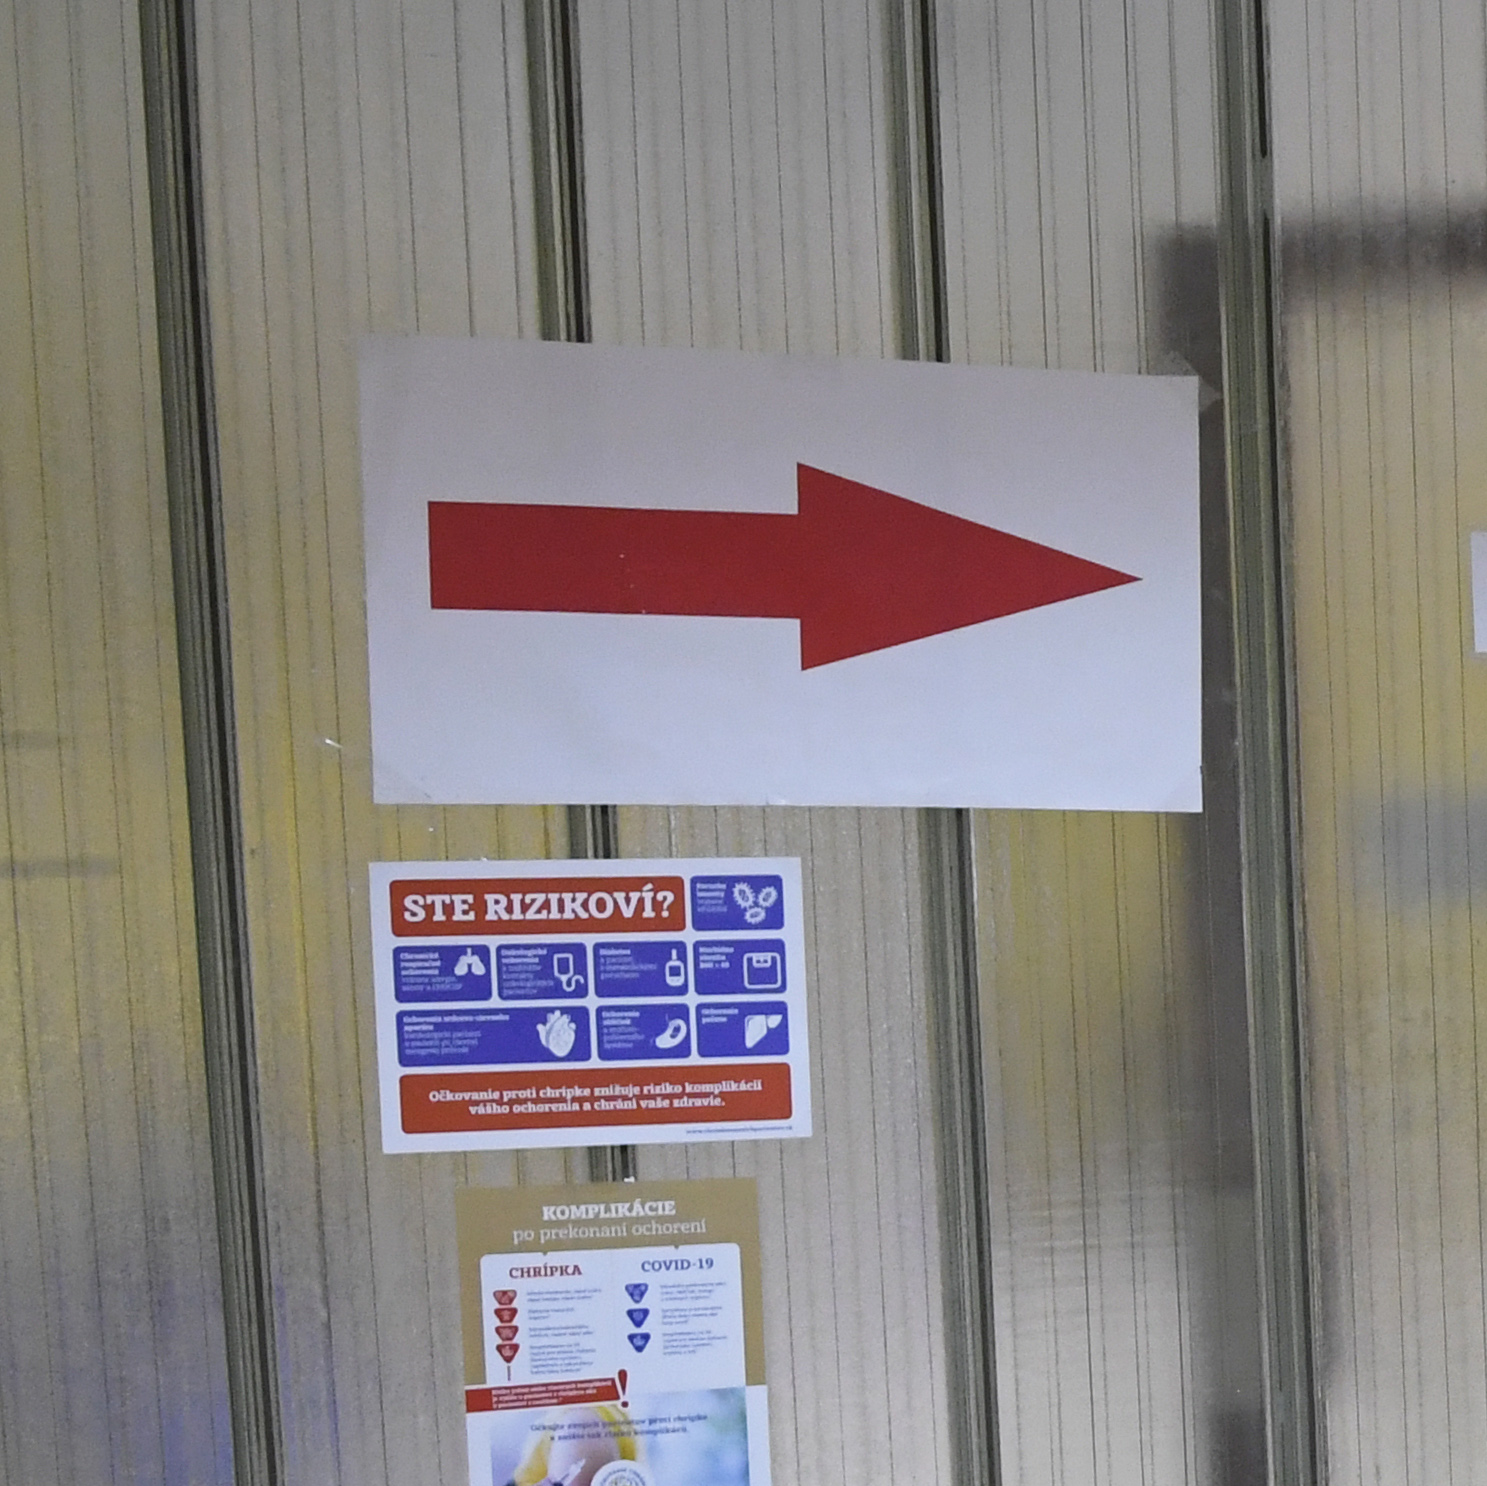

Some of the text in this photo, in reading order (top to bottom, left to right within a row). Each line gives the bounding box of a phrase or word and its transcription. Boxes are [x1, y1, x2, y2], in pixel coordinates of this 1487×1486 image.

[403, 894, 475, 922] STE
[484, 883, 675, 921] RIZIKOVÍ?
[429, 1088, 500, 1102] Očkovanie
[502, 1087, 536, 1102] proti
[643, 1081, 682, 1095] riziko
[512, 1099, 580, 1113] ochorenia
[582, 1102, 591, 1111] a
[640, 1095, 670, 1108] vaše
[673, 1095, 725, 1108] zdravie.
[542, 1198, 676, 1222] KOMPLIKÁCIE
[513, 1218, 706, 1245] po prekonaní ochorení
[509, 1262, 583, 1279] CHRÍPKA
[641, 1257, 714, 1273] COVID-19
